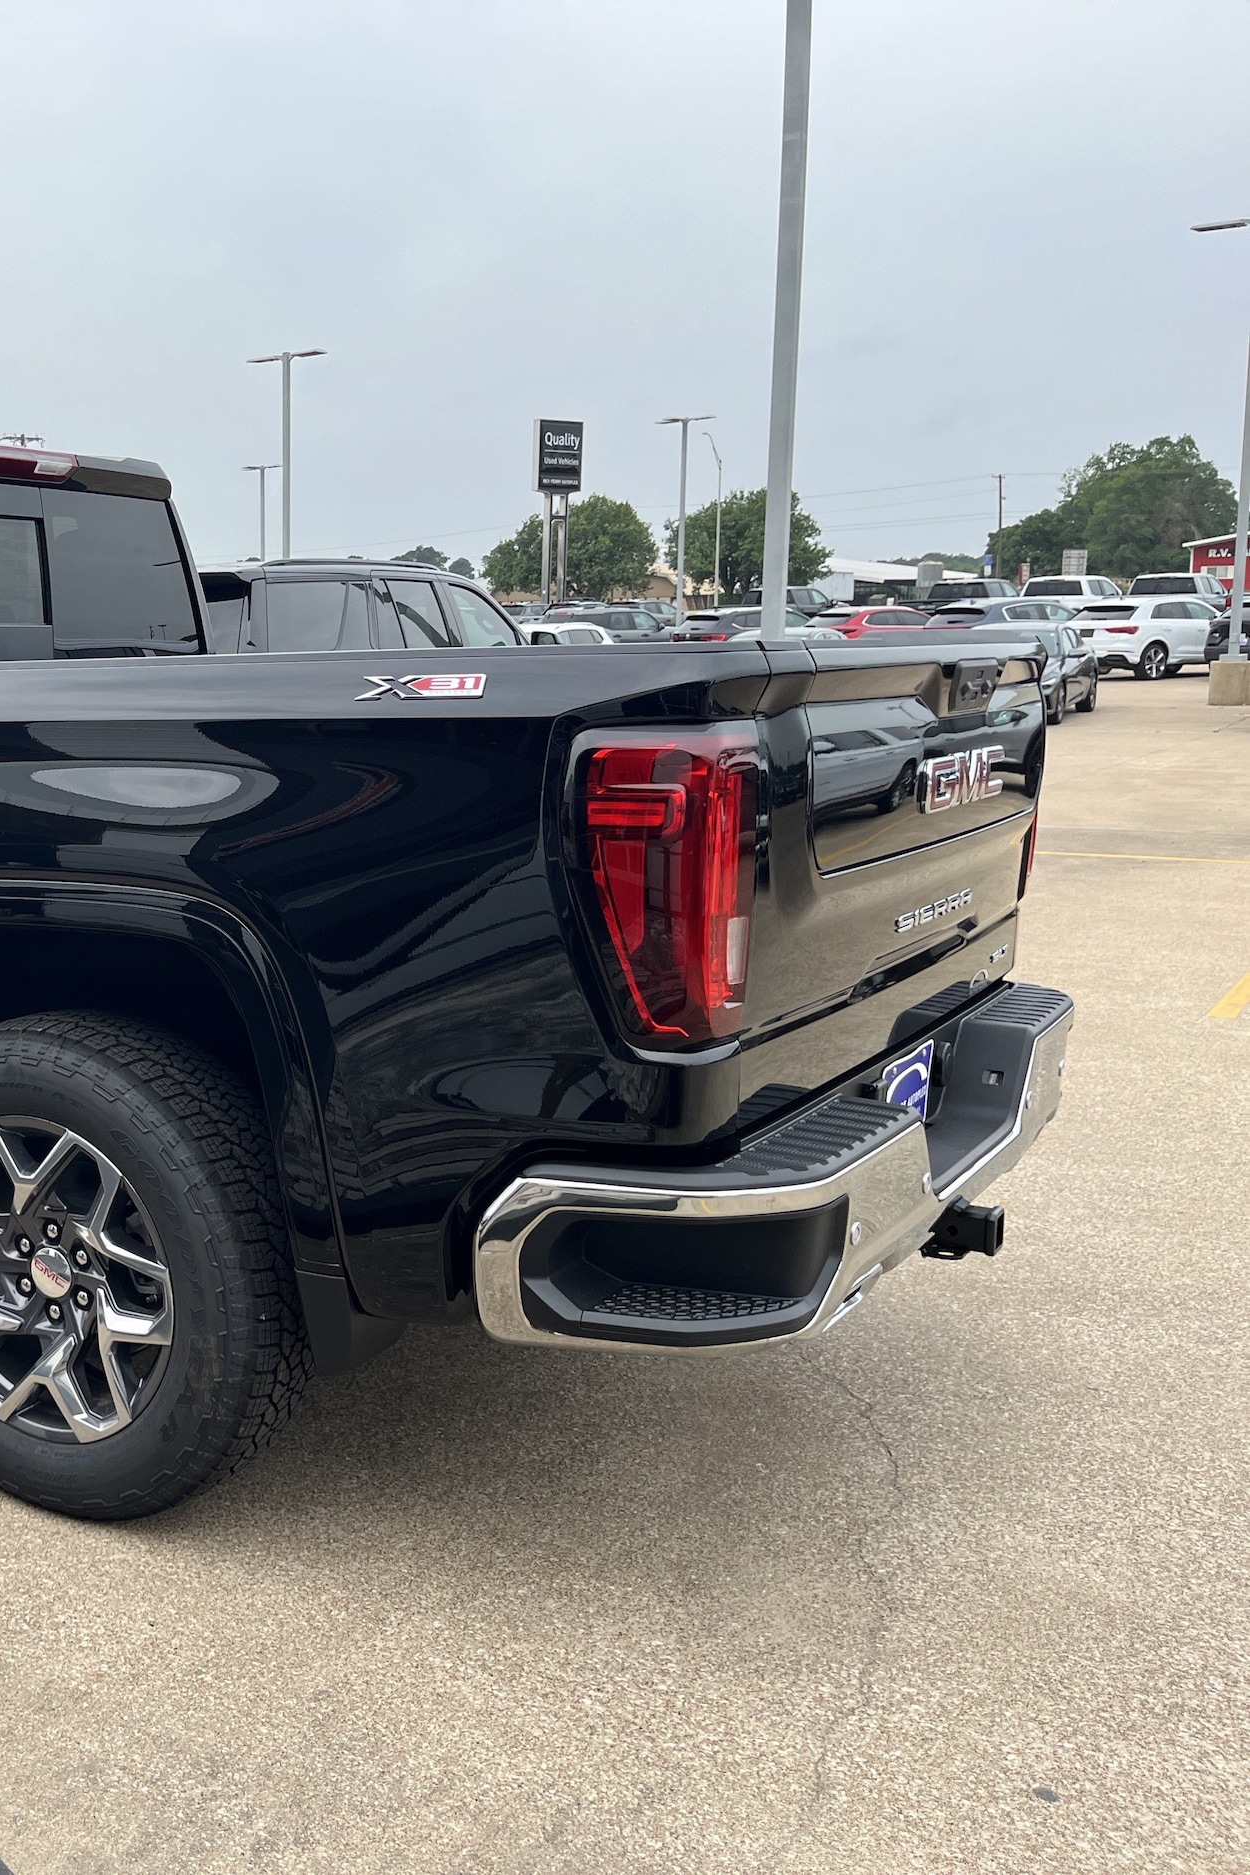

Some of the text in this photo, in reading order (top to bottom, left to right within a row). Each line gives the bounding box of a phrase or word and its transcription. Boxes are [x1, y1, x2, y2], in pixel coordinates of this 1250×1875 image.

[544, 432, 580, 450] Quality
[544, 457, 579, 466] Used Vehicles
[1208, 548, 1231, 558] R.V.
[353, 674, 487, 701] X31
[916, 745, 1005, 814] GMC
[894, 888, 972, 933] SIERRA
[989, 944, 1009, 963] SLT
[34, 1257, 68, 1289] GMC
[110, 1127, 207, 1446] GOODYEAR
